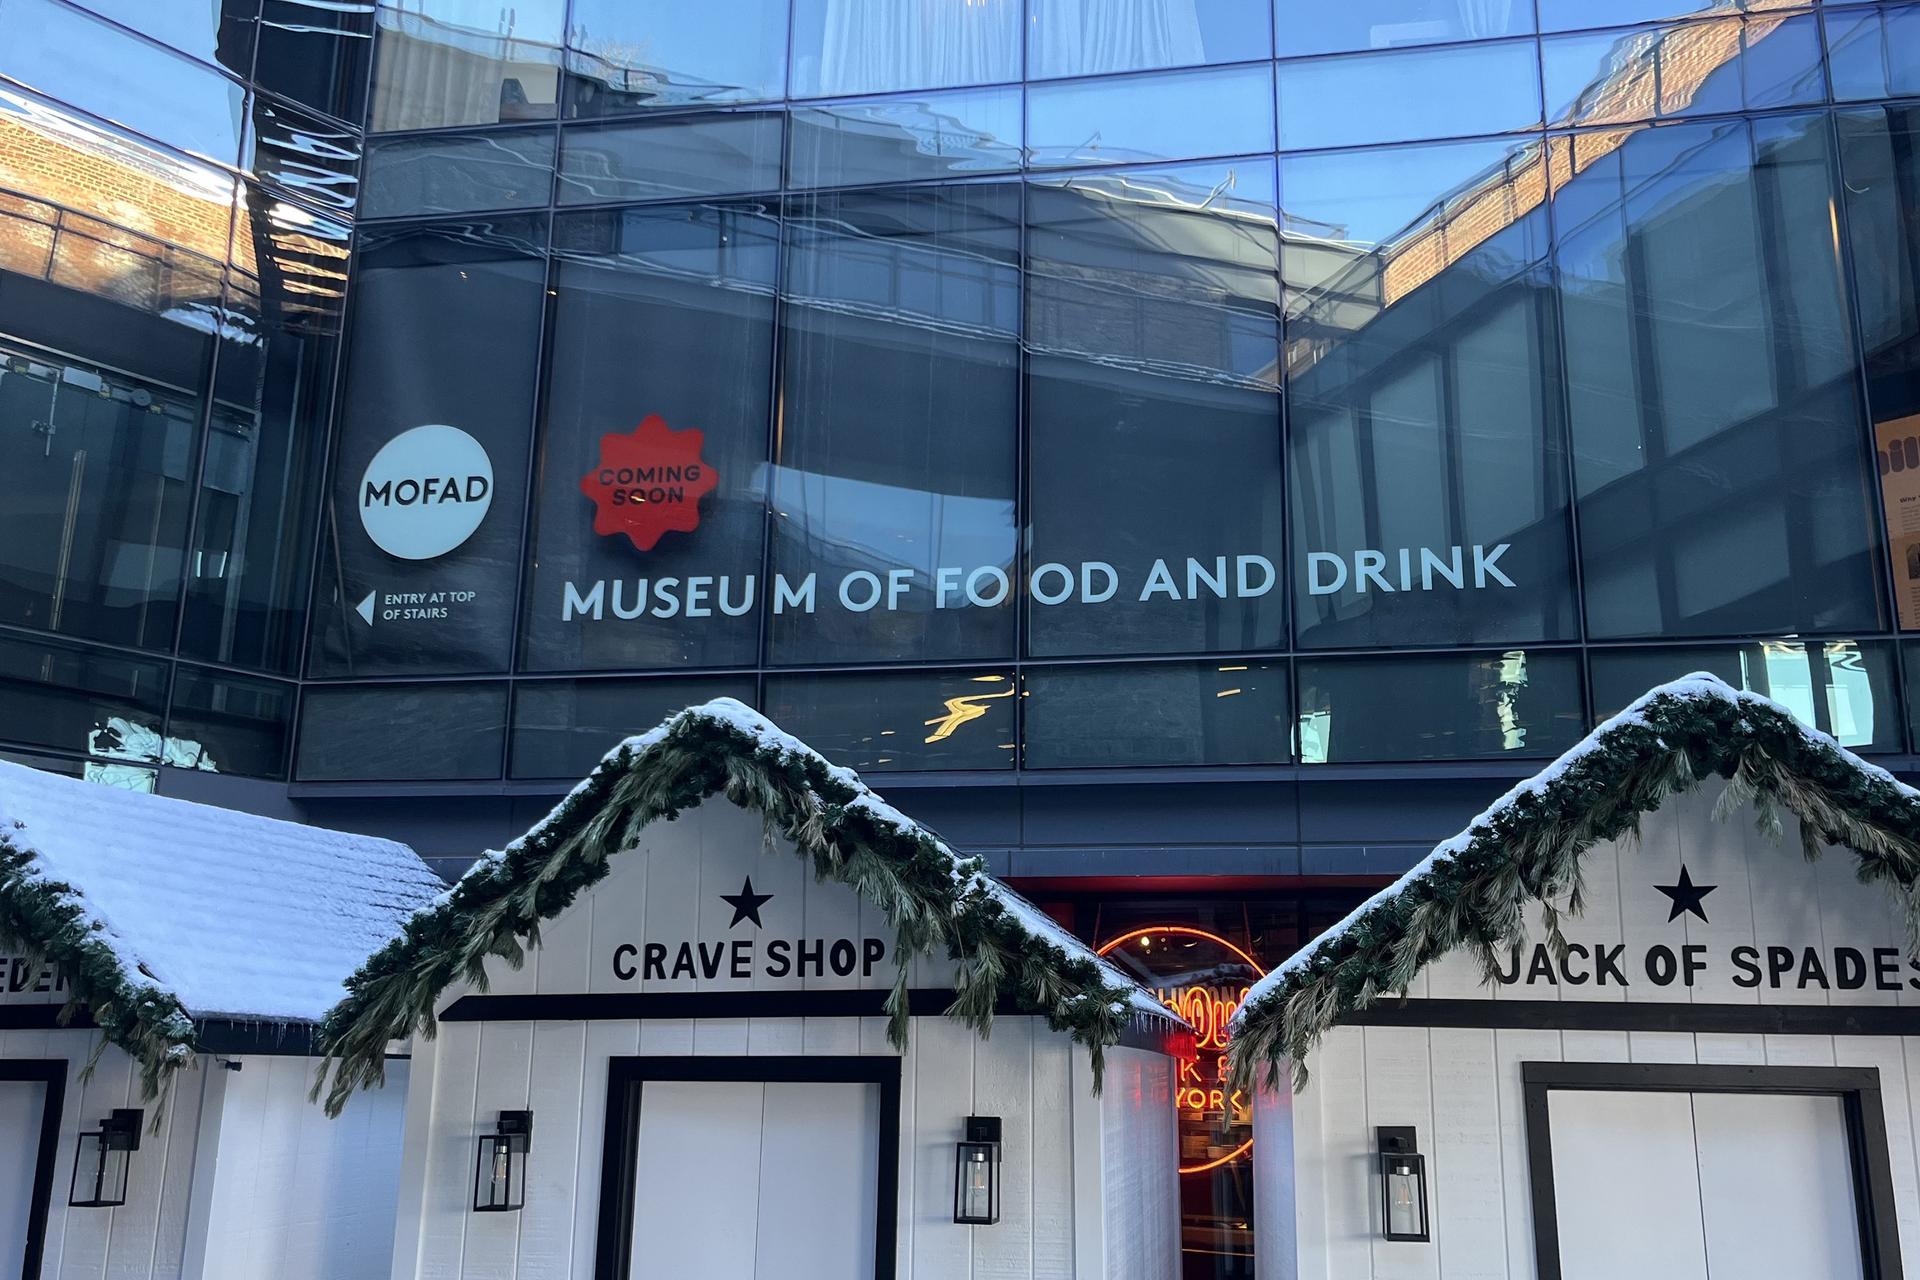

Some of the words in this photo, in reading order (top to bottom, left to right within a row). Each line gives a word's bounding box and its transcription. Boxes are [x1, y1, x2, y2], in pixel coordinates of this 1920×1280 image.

[600, 465, 701, 487] COMING
[364, 475, 489, 508] MOFAD
[612, 487, 684, 507] SOON
[562, 572, 817, 622] MUSEUM
[838, 569, 915, 613] OF
[936, 561, 1120, 609] FOOD
[1138, 554, 1276, 602] AND
[1307, 543, 1518, 596] DRINK
[384, 593, 427, 605] ENTRY
[429, 592, 447, 604] AT
[450, 591, 476, 602] TOP
[383, 609, 402, 620] OF
[403, 607, 448, 619] STAIRS
[612, 940, 753, 981] CRAVE
[765, 938, 886, 978] SHOP
[1498, 943, 1629, 987] JACK
[1645, 944, 1708, 987] OF
